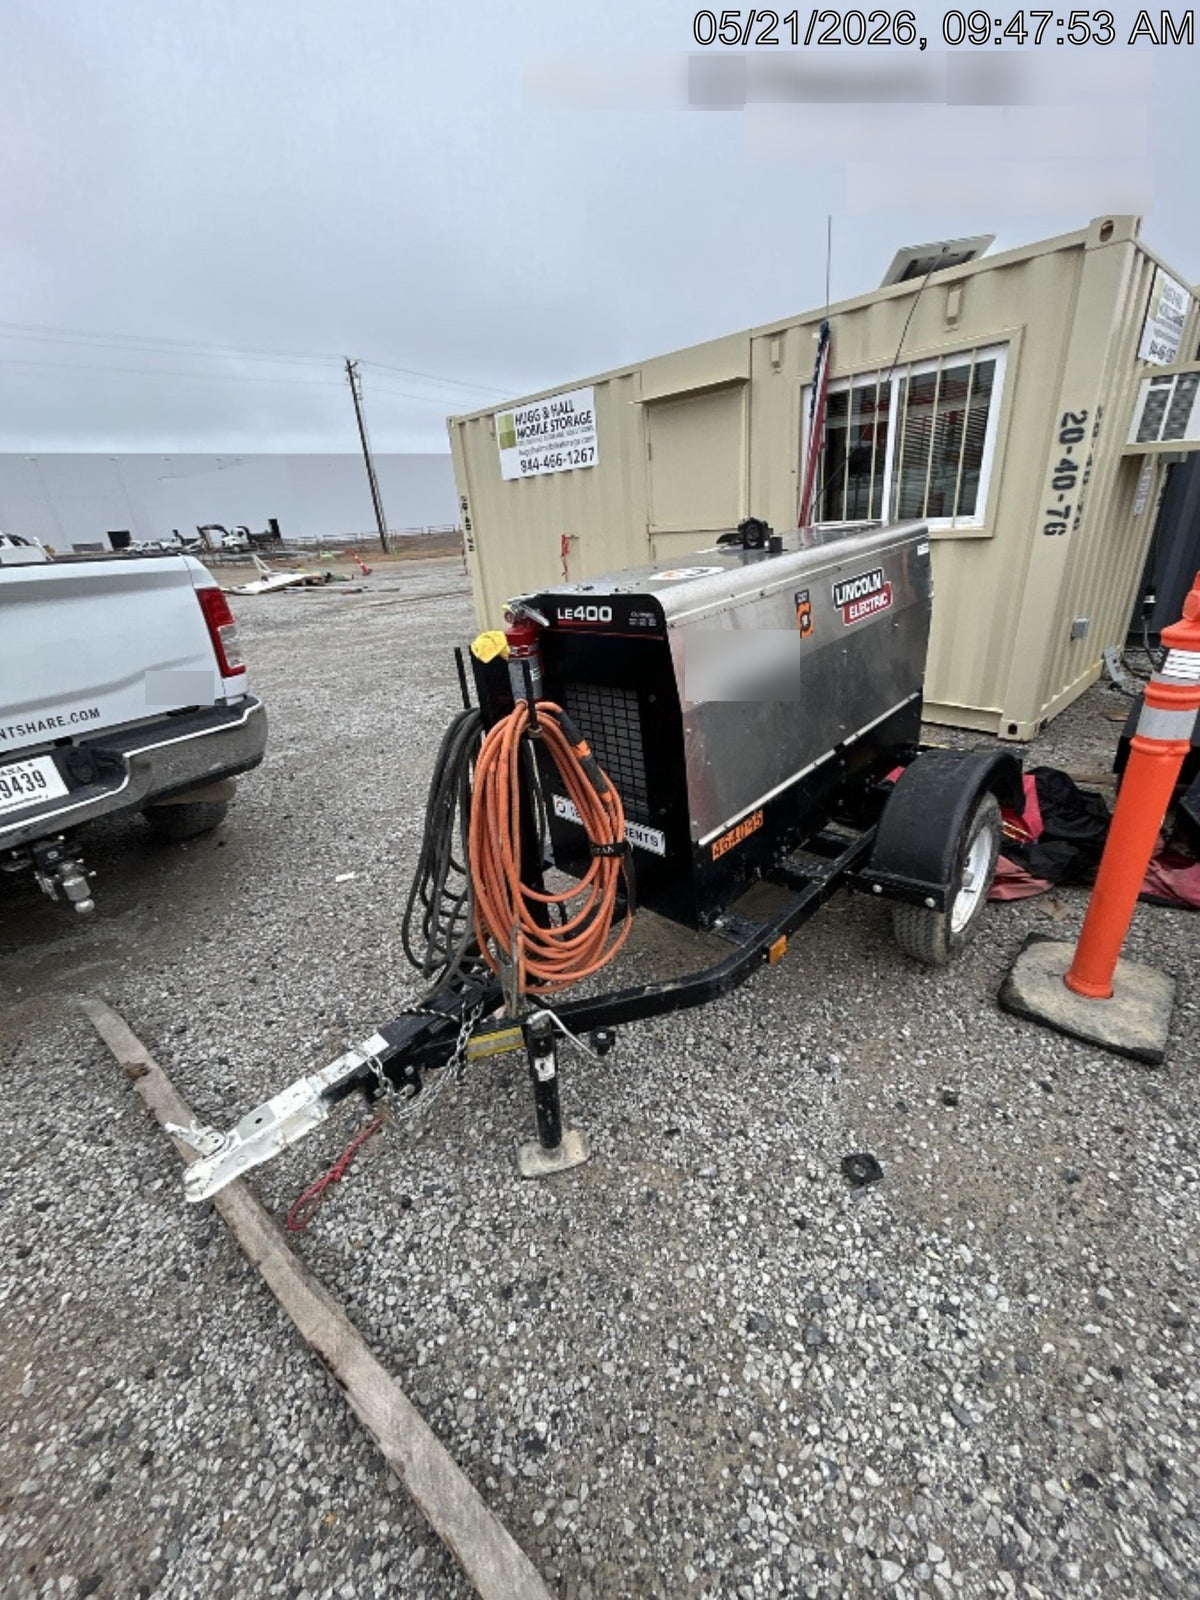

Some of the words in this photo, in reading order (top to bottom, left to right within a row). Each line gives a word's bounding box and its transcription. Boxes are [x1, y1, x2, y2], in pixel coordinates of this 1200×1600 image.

[515, 408, 541, 426] HUGG
[543, 406, 550, 420] &
[551, 399, 575, 417] HALL
[517, 419, 549, 439] MOBILE
[550, 410, 593, 433] STORAGE
[1043, 409, 1088, 536] 20-40-76
[835, 572, 882, 606] LINCOLN
[557, 606, 613, 622] LE400
[849, 591, 889, 620] ELECTRIC
[0, 707, 101, 741] NTSHARE.COM
